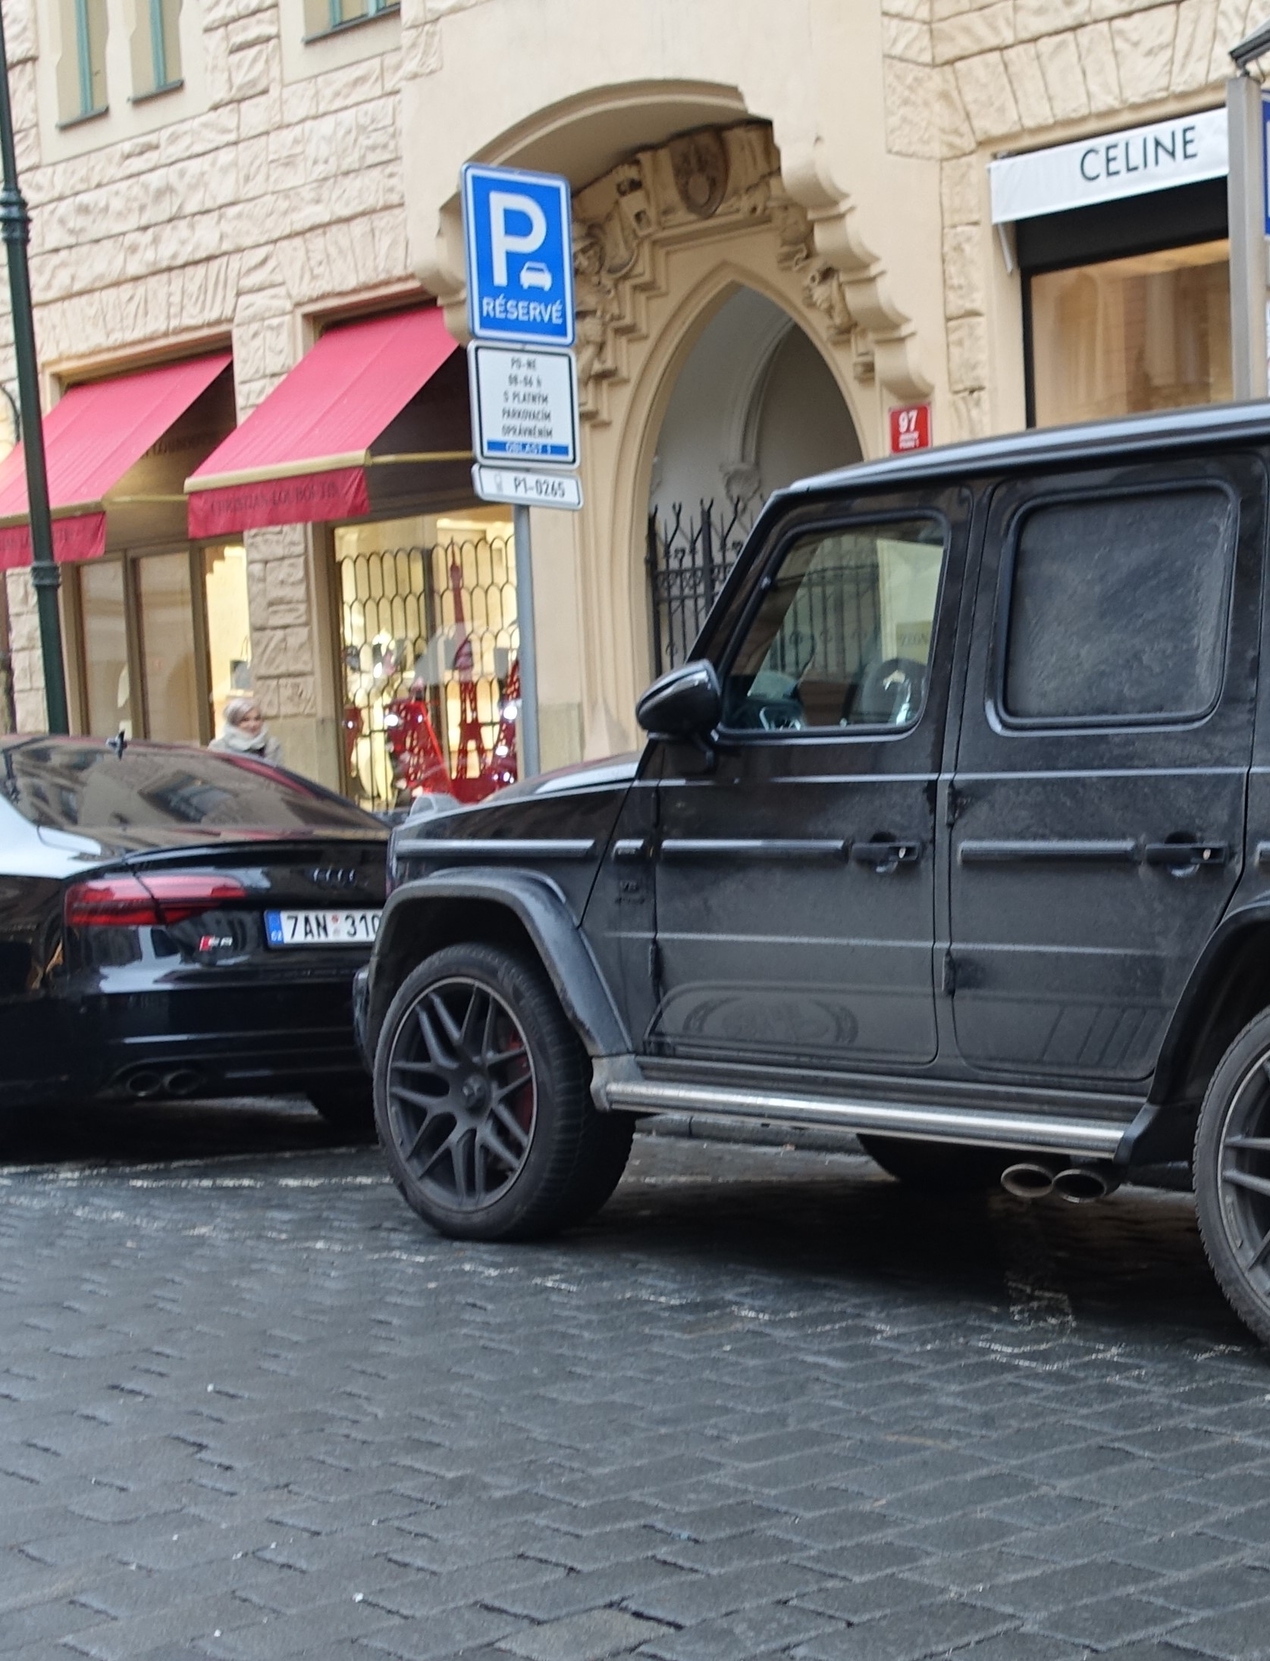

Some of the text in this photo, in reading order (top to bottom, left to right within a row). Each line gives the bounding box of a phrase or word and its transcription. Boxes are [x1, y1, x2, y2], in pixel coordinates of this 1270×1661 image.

[1080, 125, 1199, 181] CELINE
[488, 190, 547, 287] P
[482, 295, 564, 324] RÉSERVÉ
[501, 407, 552, 422] PARKOVACÍM
[899, 409, 918, 434] 97
[513, 476, 566, 498] P1-0265
[286, 913, 329, 940] 7AN
